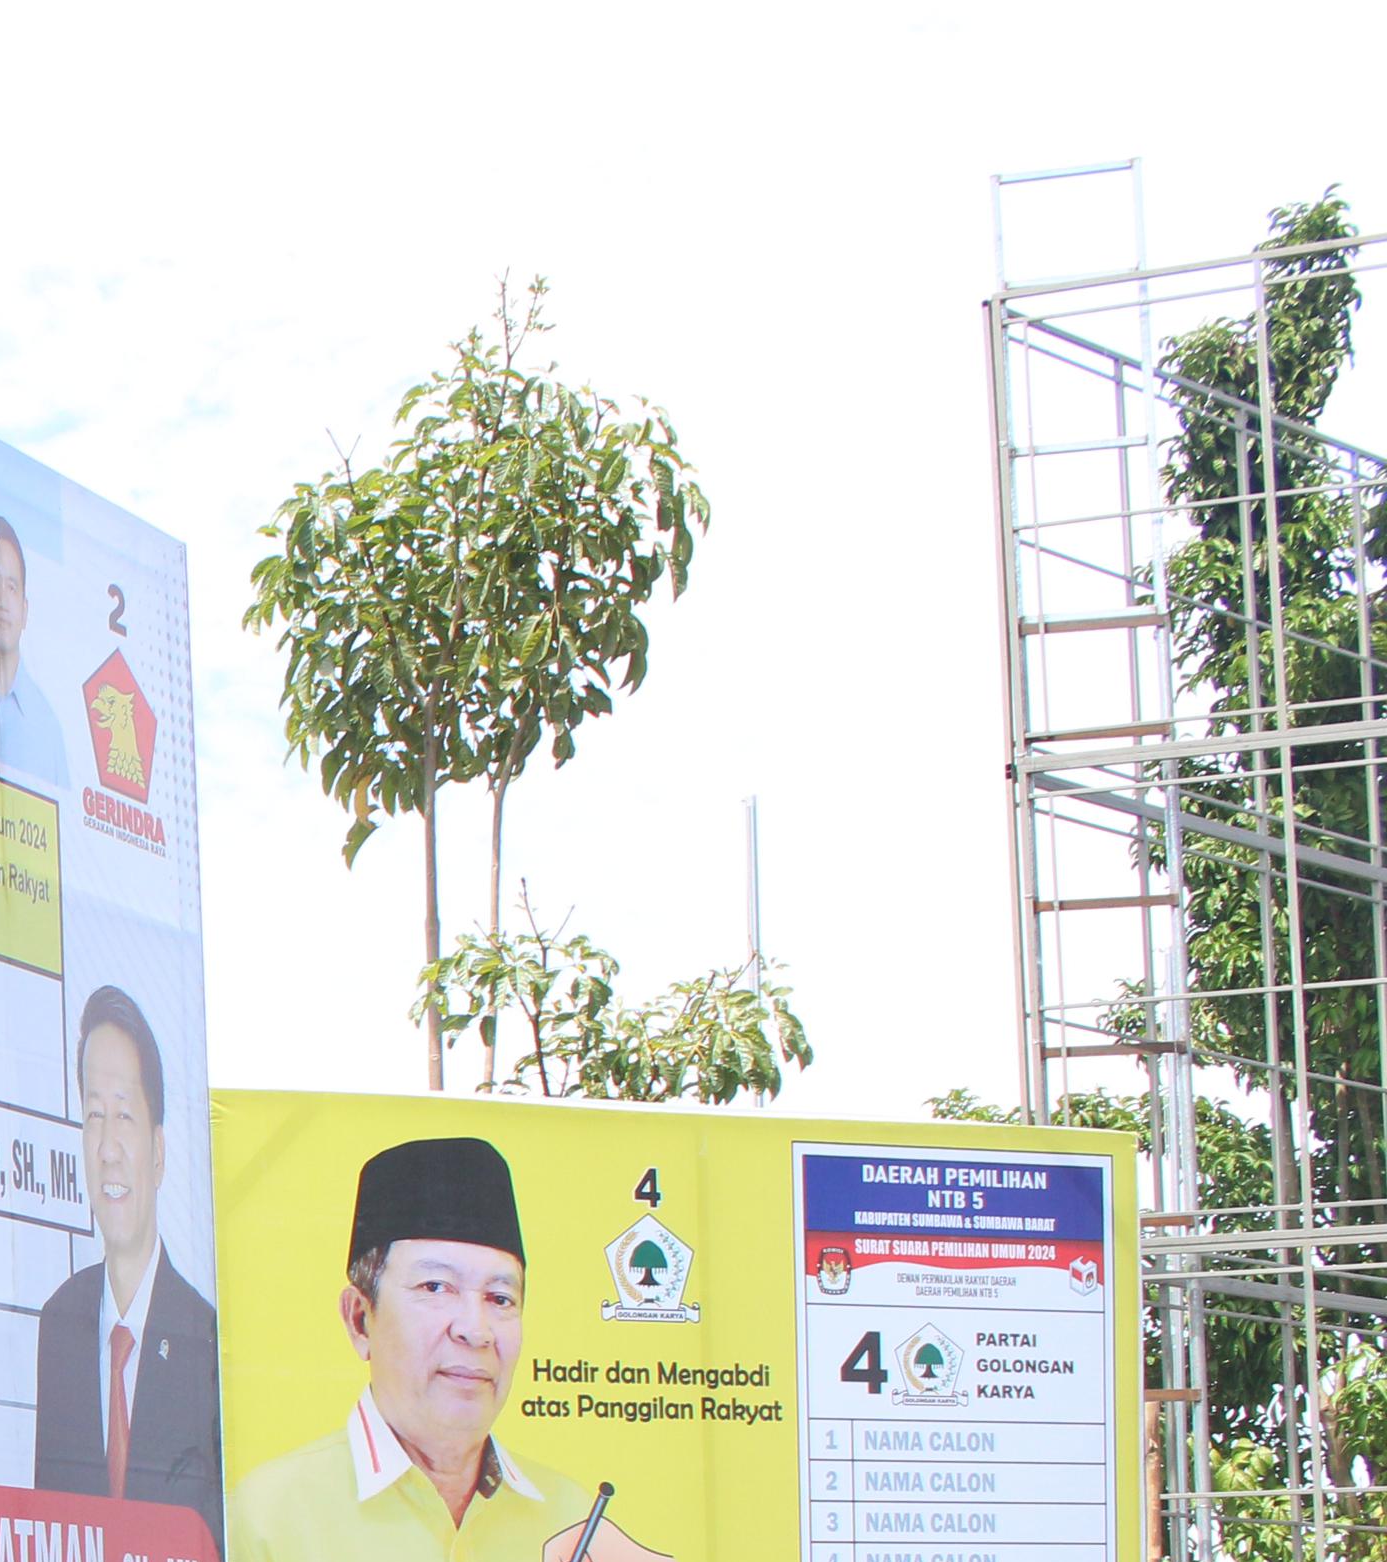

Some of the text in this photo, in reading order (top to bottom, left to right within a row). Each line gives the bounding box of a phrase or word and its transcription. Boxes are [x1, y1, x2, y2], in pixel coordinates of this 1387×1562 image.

[108, 583, 127, 637] 2
[82, 786, 167, 848] GERINDRA
[19, 818, 48, 852] 2024
[9, 863, 51, 904] Rakyat
[11, 1138, 46, 1204] SH.,
[50, 1149, 84, 1204] MH.
[861, 1164, 1047, 1190] DAERAH PEMILIHAN
[634, 1167, 662, 1208] 4
[927, 1190, 985, 1210] NTB 5
[854, 1211, 1056, 1232] KABUPATEN SUMBAWA & SUMBAWA BARAT
[854, 1239, 891, 1256] SURAT
[892, 1240, 931, 1257] SUARA
[931, 1241, 990, 1259] PEMILIHAN
[991, 1243, 1026, 1260] UMUM
[1027, 1244, 1056, 1261] 2024
[976, 1333, 1038, 1348] PARTAI
[532, 1358, 770, 1390] Hadir dan Mengabdi
[839, 1331, 889, 1395] 4
[976, 1359, 1075, 1375] GOLONGAN
[976, 1384, 1036, 1400] KARYA
[521, 1394, 783, 1426] atas Panggilan Rakyat
[824, 1430, 996, 1452] 1 NAMA CALON
[825, 1471, 996, 1493] 2 NAMA CALON
[826, 1512, 996, 1534] 3 NAMA CALON
